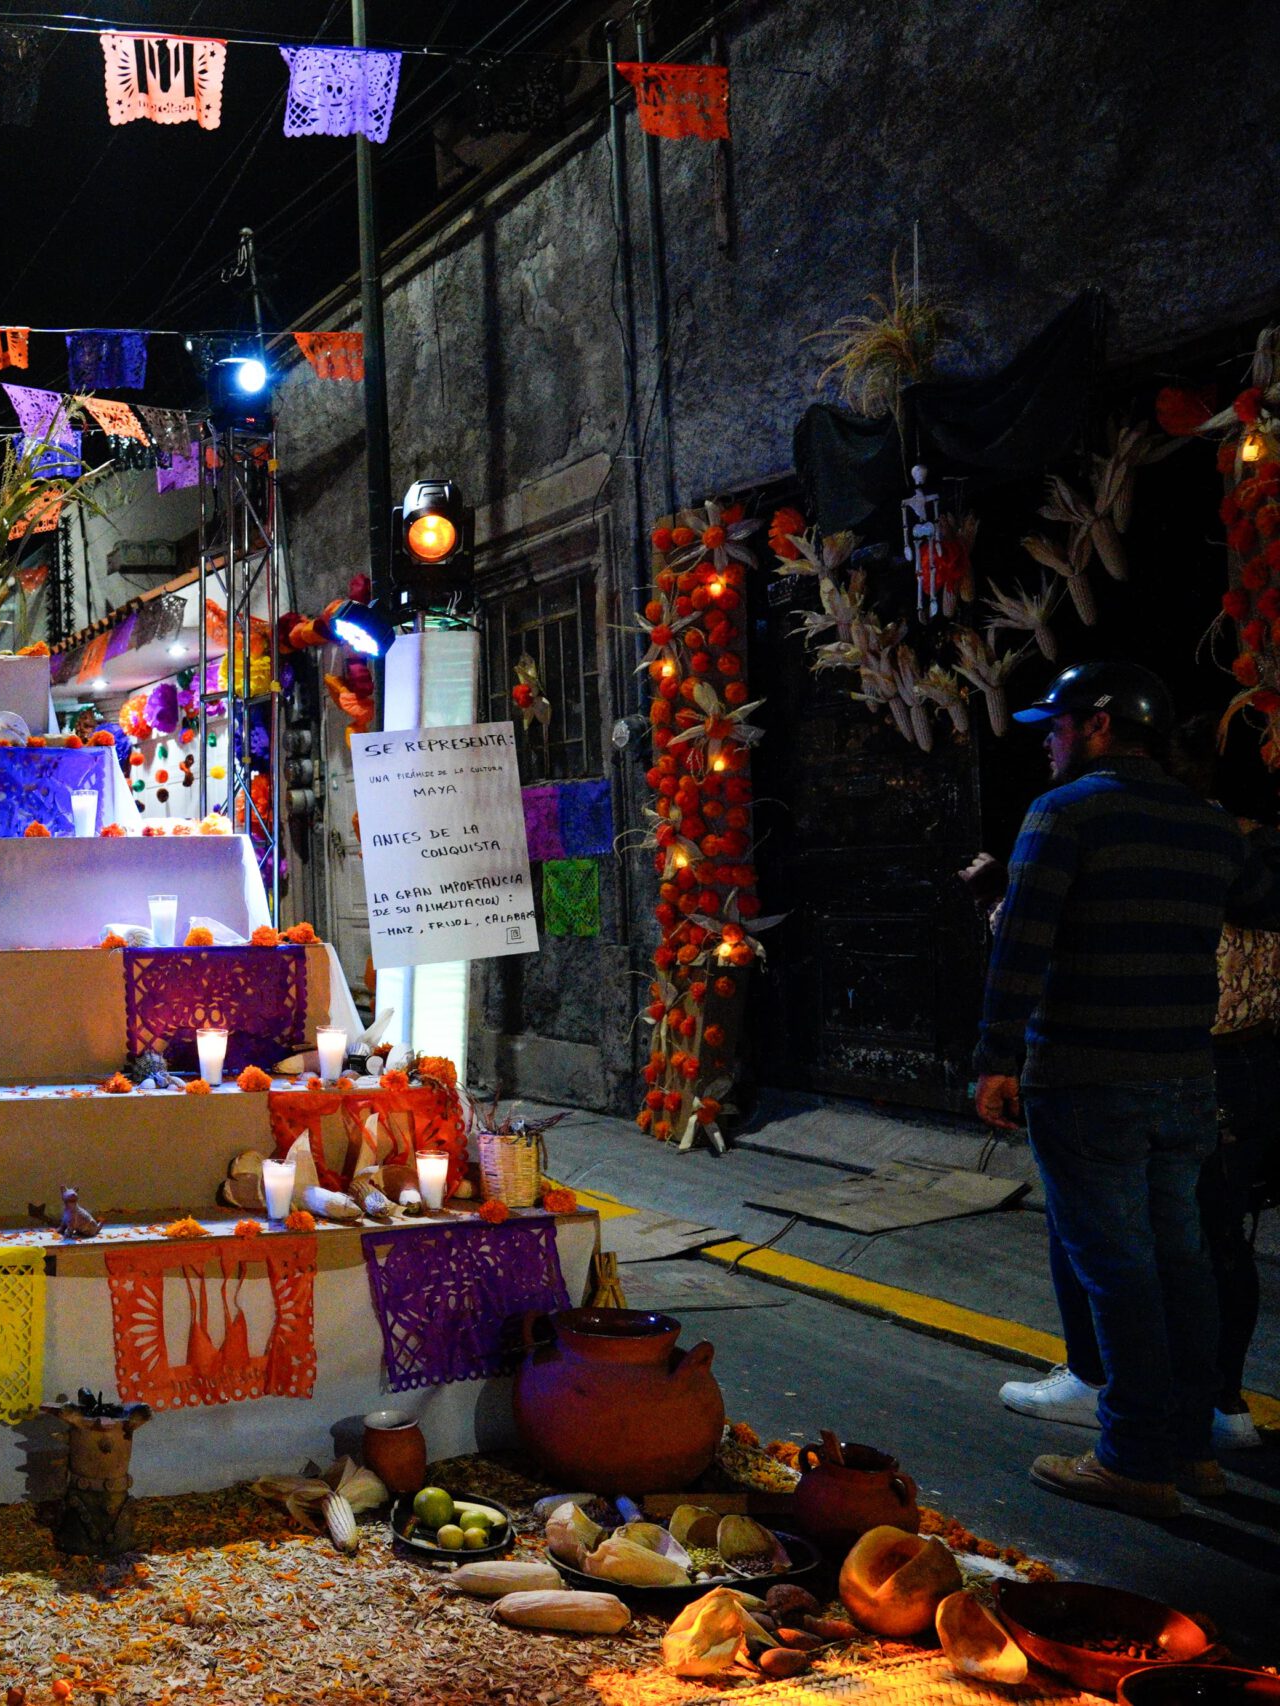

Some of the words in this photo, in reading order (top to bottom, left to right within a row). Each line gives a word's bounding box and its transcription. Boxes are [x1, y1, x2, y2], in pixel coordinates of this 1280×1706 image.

[364, 742, 394, 757] SE
[405, 734, 515, 752] REPRESENTA:
[369, 774, 390, 784] UNA
[454, 767, 464, 775] LA
[413, 784, 457, 798] MAYA
[372, 831, 422, 847] ANTES
[429, 828, 450, 839] DE
[463, 824, 479, 836] LA
[421, 840, 501, 859] CONQUISTA
[374, 893, 389, 904] LA
[395, 887, 432, 900] GRAN
[439, 873, 523, 894] IMPORTANCIA
[372, 908, 391, 917] DE
[396, 906, 411, 914] SU
